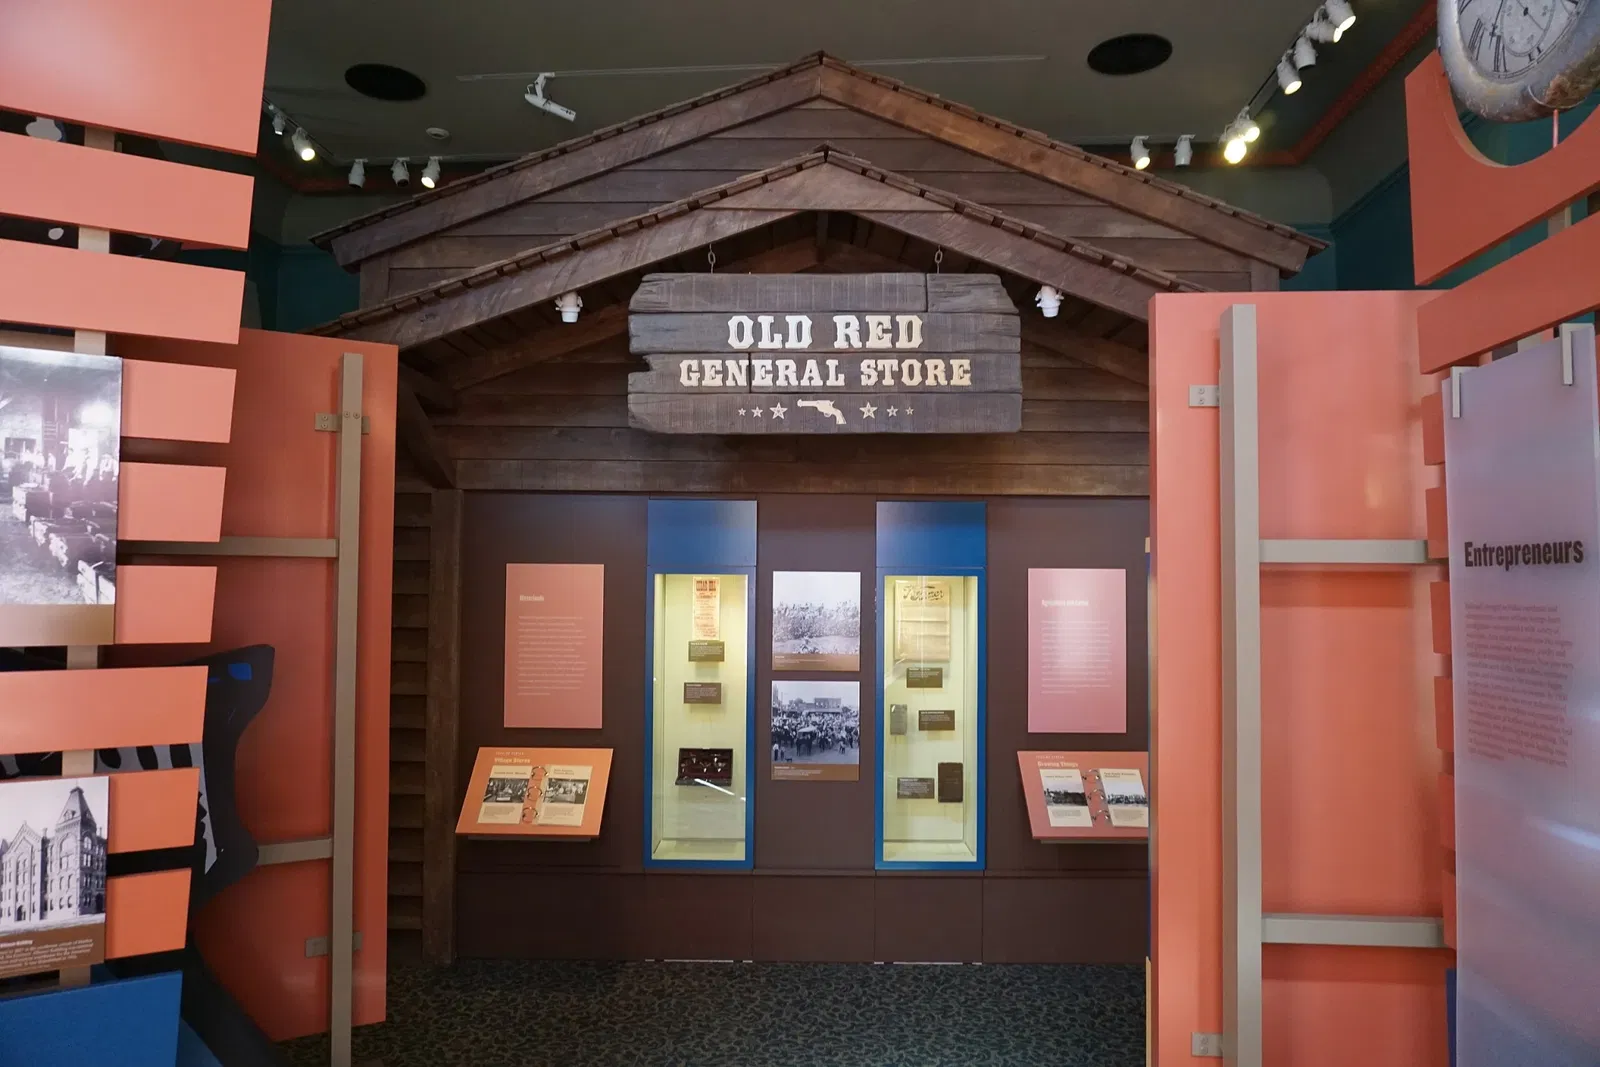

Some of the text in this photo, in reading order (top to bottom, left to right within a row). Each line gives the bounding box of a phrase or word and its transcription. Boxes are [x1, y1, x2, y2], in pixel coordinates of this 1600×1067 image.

[727, 315, 923, 349] OLD RED
[679, 359, 972, 387] GENERAL STORE
[1464, 540, 1584, 571] Entrepreneurs
